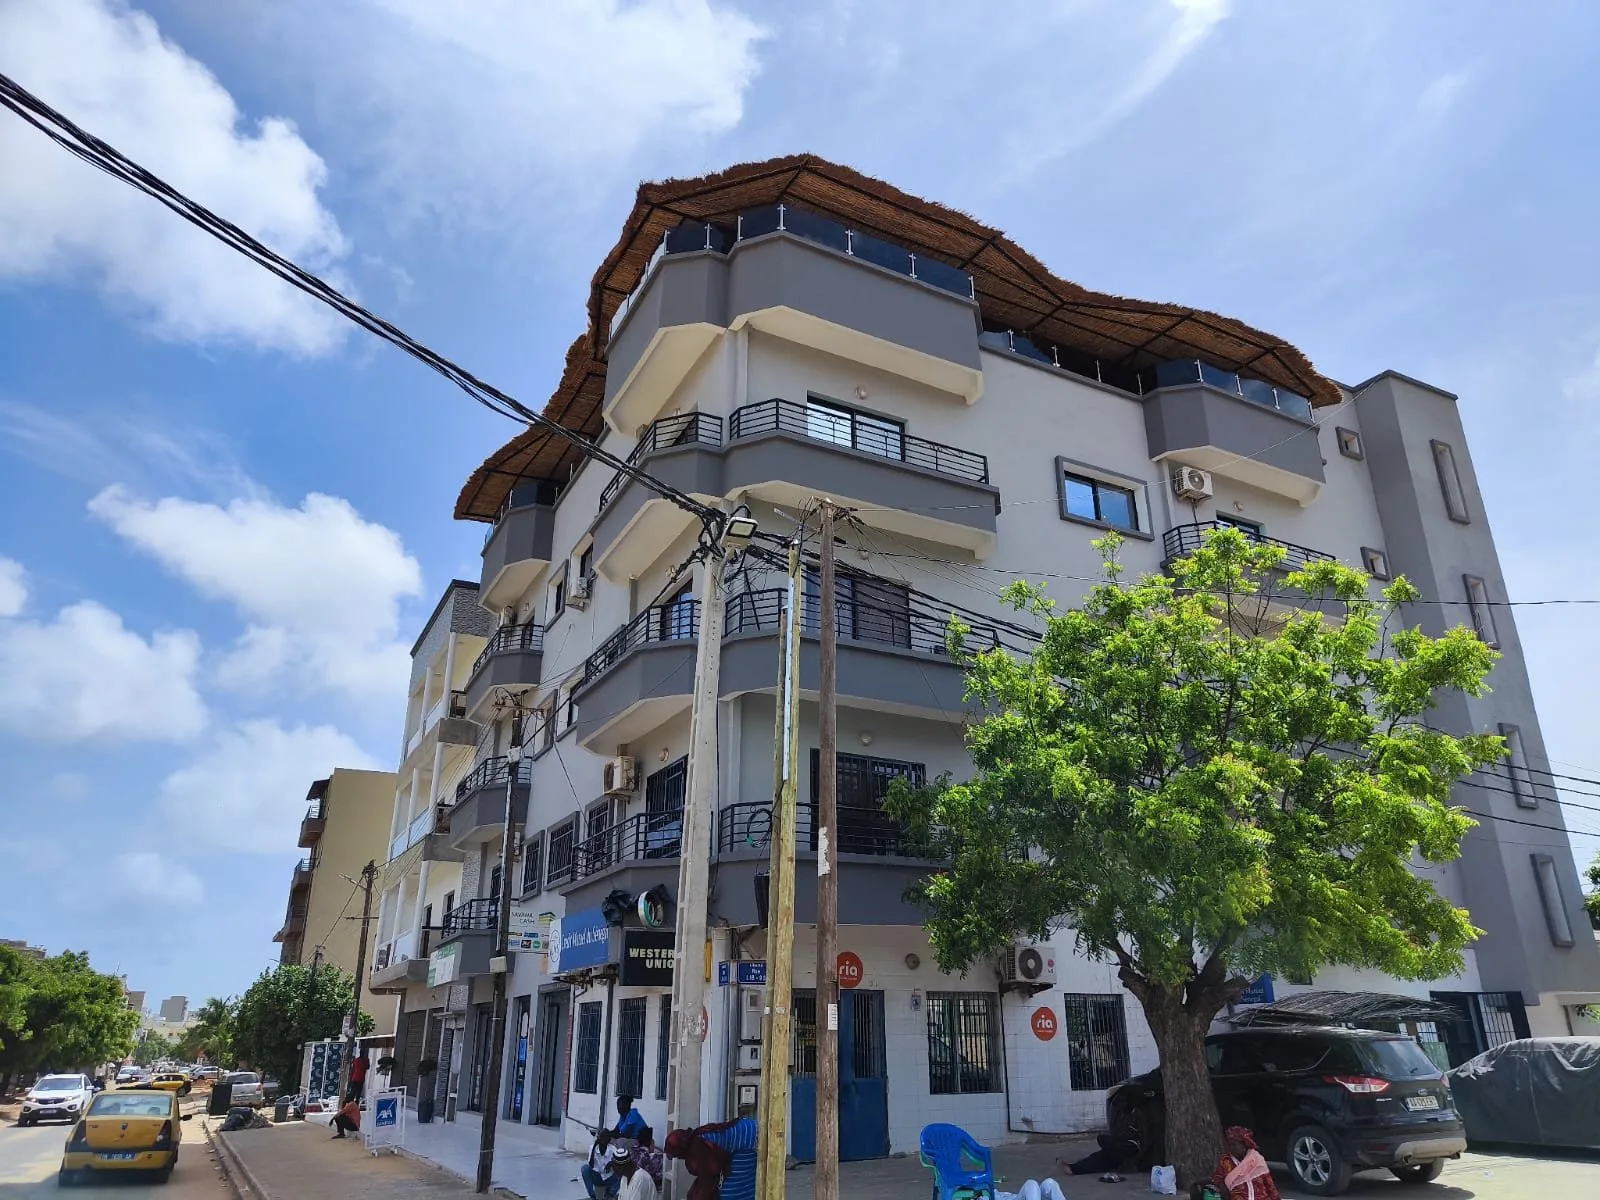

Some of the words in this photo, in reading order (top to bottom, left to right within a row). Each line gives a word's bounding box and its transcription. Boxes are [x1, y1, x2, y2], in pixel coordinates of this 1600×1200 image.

[629, 948, 675, 958] WESTER
[645, 959, 675, 969] UNIO
[839, 960, 858, 977] ria
[1037, 1014, 1054, 1029] ria
